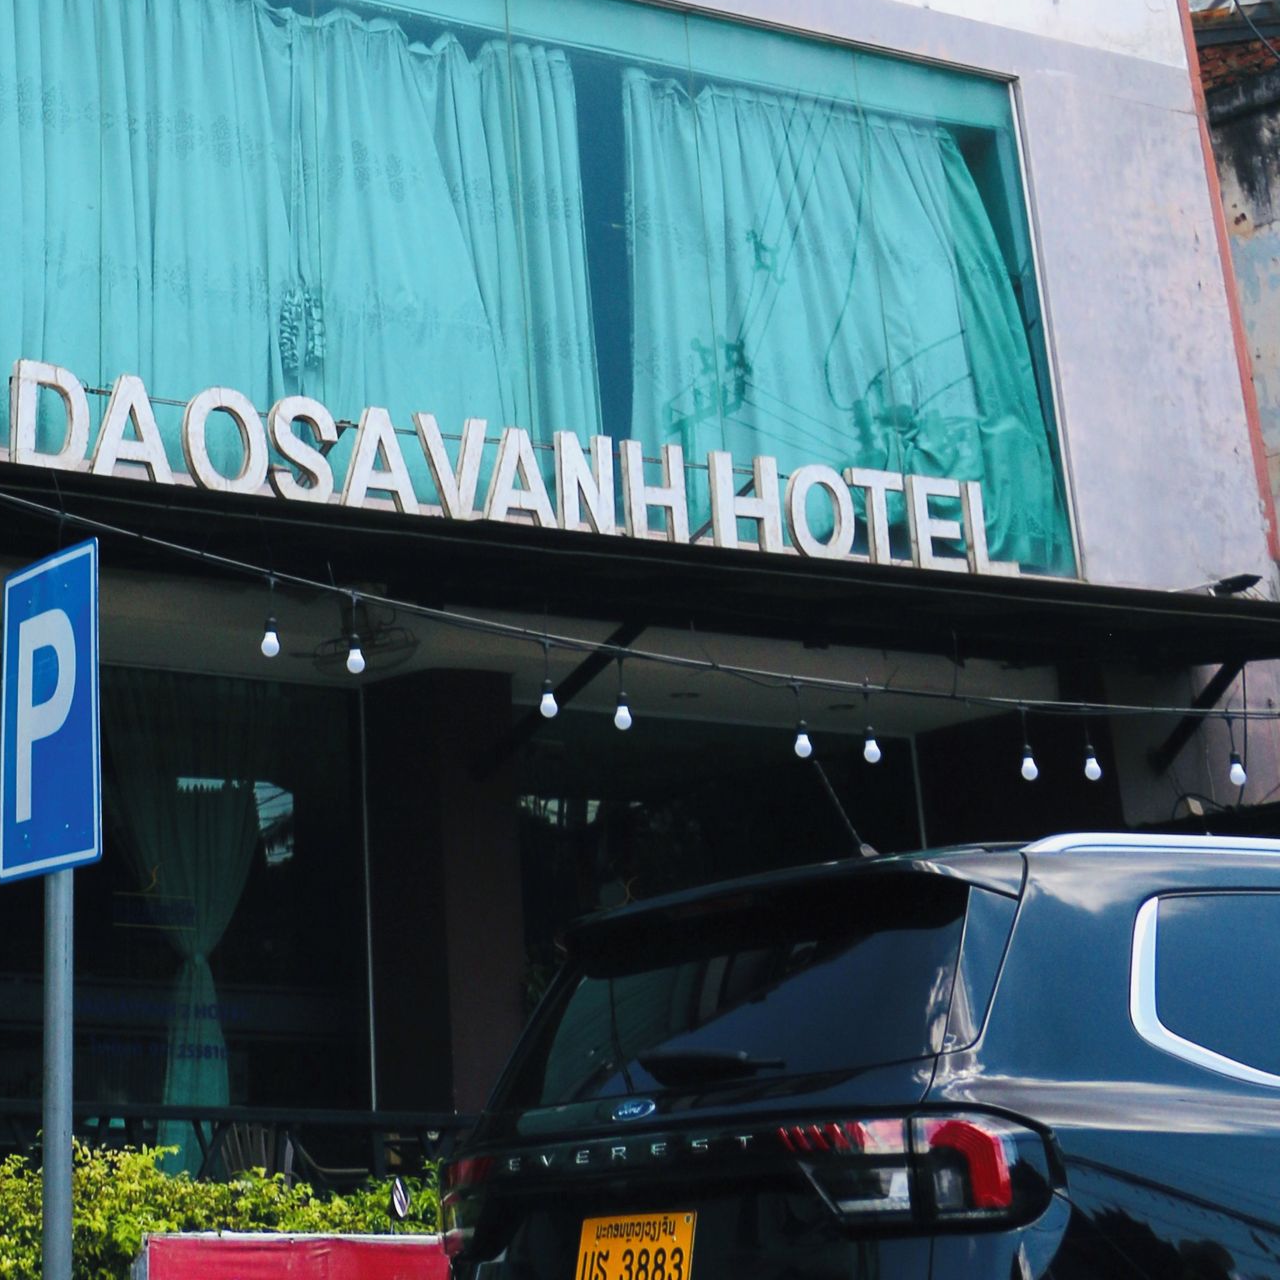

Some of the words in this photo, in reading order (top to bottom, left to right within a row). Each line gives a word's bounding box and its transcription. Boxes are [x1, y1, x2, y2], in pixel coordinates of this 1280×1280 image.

[9, 359, 690, 543] DAOSAVANH
[707, 451, 1020, 576] HOTEL
[16, 608, 76, 823] P
[508, 1134, 754, 1172] EVEREST
[618, 1247, 685, 1280] 3883
